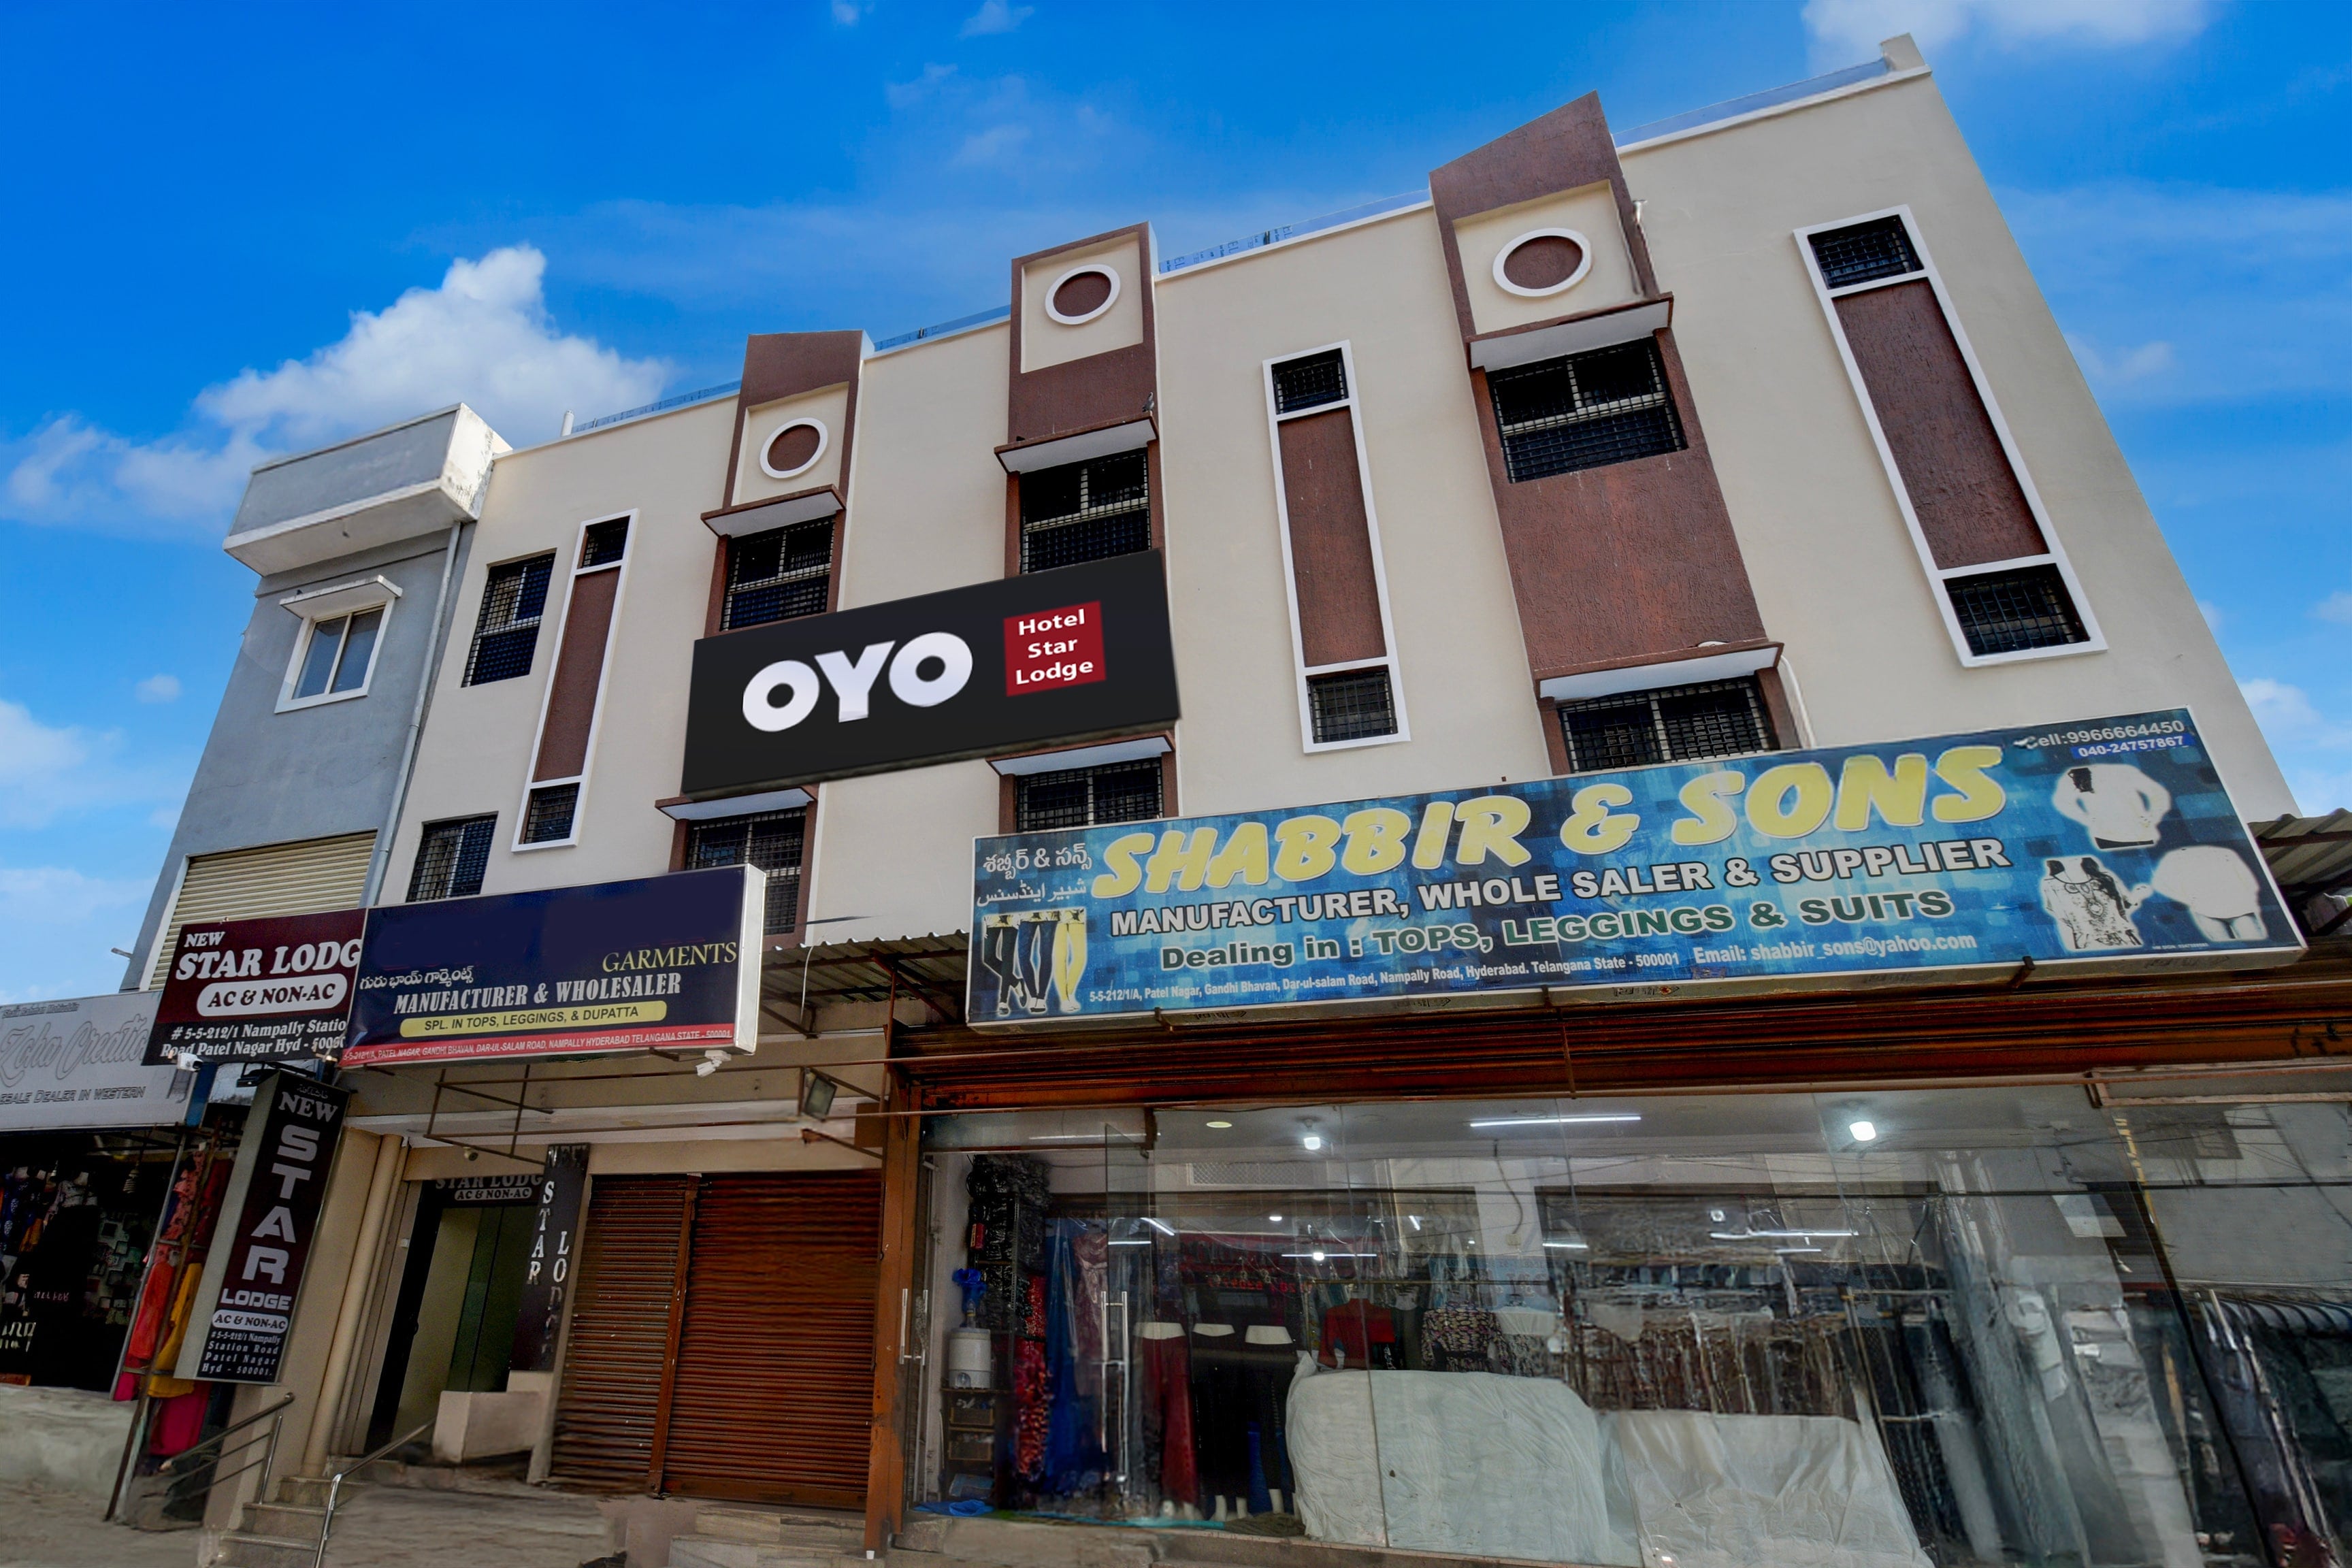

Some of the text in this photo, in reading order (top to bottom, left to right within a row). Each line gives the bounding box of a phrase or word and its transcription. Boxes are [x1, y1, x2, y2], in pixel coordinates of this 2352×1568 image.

[1018, 608, 1086, 636] Hotel
[1027, 636, 1079, 659] Star
[742, 632, 973, 732] OYO
[1015, 659, 1094, 685] Lodge
[2078, 736, 2184, 757] 040-24757867
[1091, 745, 2006, 899] SHABBIR & SONS
[1034, 848, 1051, 868] &
[1056, 843, 1092, 870] సన్స్
[1110, 837, 2012, 938] MANUFACTURER, WHOLE SALER & SUPPLIER
[184, 932, 225, 947] NEW
[1161, 939, 1294, 970] Dealing
[1305, 934, 1339, 961] in
[1373, 922, 1493, 953] TOPS,
[1504, 904, 1735, 946] LEGGINGS
[1750, 901, 1788, 930] &
[1799, 889, 1956, 926] SUITS
[176, 938, 363, 980] STAR LODG
[602, 942, 737, 973] GARMENTS
[1089, 989, 1143, 1003] 5-5-212/1/A,
[1145, 986, 1169, 998] Patel
[1171, 985, 1203, 1000] Nagar,
[1204, 982, 1239, 996] Gandhi
[1241, 980, 1281, 994] Bhavan,
[1283, 975, 1346, 990] Dar-ul-salam
[1348, 973, 1378, 986] Road,
[1380, 969, 1430, 985] Nampally
[1432, 967, 1465, 981] Road,
[1465, 962, 1530, 979] Hyderabad.
[1531, 958, 1592, 975] Telangana
[1593, 956, 1627, 969] State
[1636, 952, 1680, 967] 500001
[1693, 945, 1748, 964] Email:
[1750, 934, 1978, 962] shabbir_sons@yahoo.com
[208, 983, 336, 1007] AC & NON-AC
[393, 972, 681, 1014] MANUFACTURER & WHOLESALER
[171, 1019, 346, 1041] # 5-5-212/1 Nampally Statio
[425, 1007, 638, 1030] SPL. IN TOPS, LEGGINGS, & DUPATTA
[161, 1043, 195, 1056] Road
[196, 1041, 231, 1056] Patel
[233, 1042, 271, 1058] Nagar
[274, 1038, 301, 1056] Hyd
[378, 1049, 397, 1058] PATEL
[423, 1047, 447, 1056] GANDHI
[476, 1041, 526, 1053] DAR-UL-SALAM
[549, 1038, 585, 1049] NAMPALLY
[586, 1034, 630, 1046] HYDERABAD
[632, 1032, 676, 1043] TELANGANA
[677, 1030, 700, 1039] STATE
[33, 1090, 77, 1103] DEALER
[78, 1089, 92, 1101] IN
[94, 1086, 146, 1100] WESTERN
[278, 1092, 338, 1122] NEW
[242, 1124, 321, 1284] STAR
[457, 1188, 529, 1199] AC & NON-AC
[527, 1181, 555, 1285] STAR
[220, 1288, 292, 1311] LODGE
[214, 1314, 286, 1329] AC & NON-AC
[208, 1341, 279, 1354] Station Road
[248, 1333, 281, 1345] Nampally
[201, 1362, 223, 1373] Hyd
[205, 1352, 276, 1366] Patel Nagar
